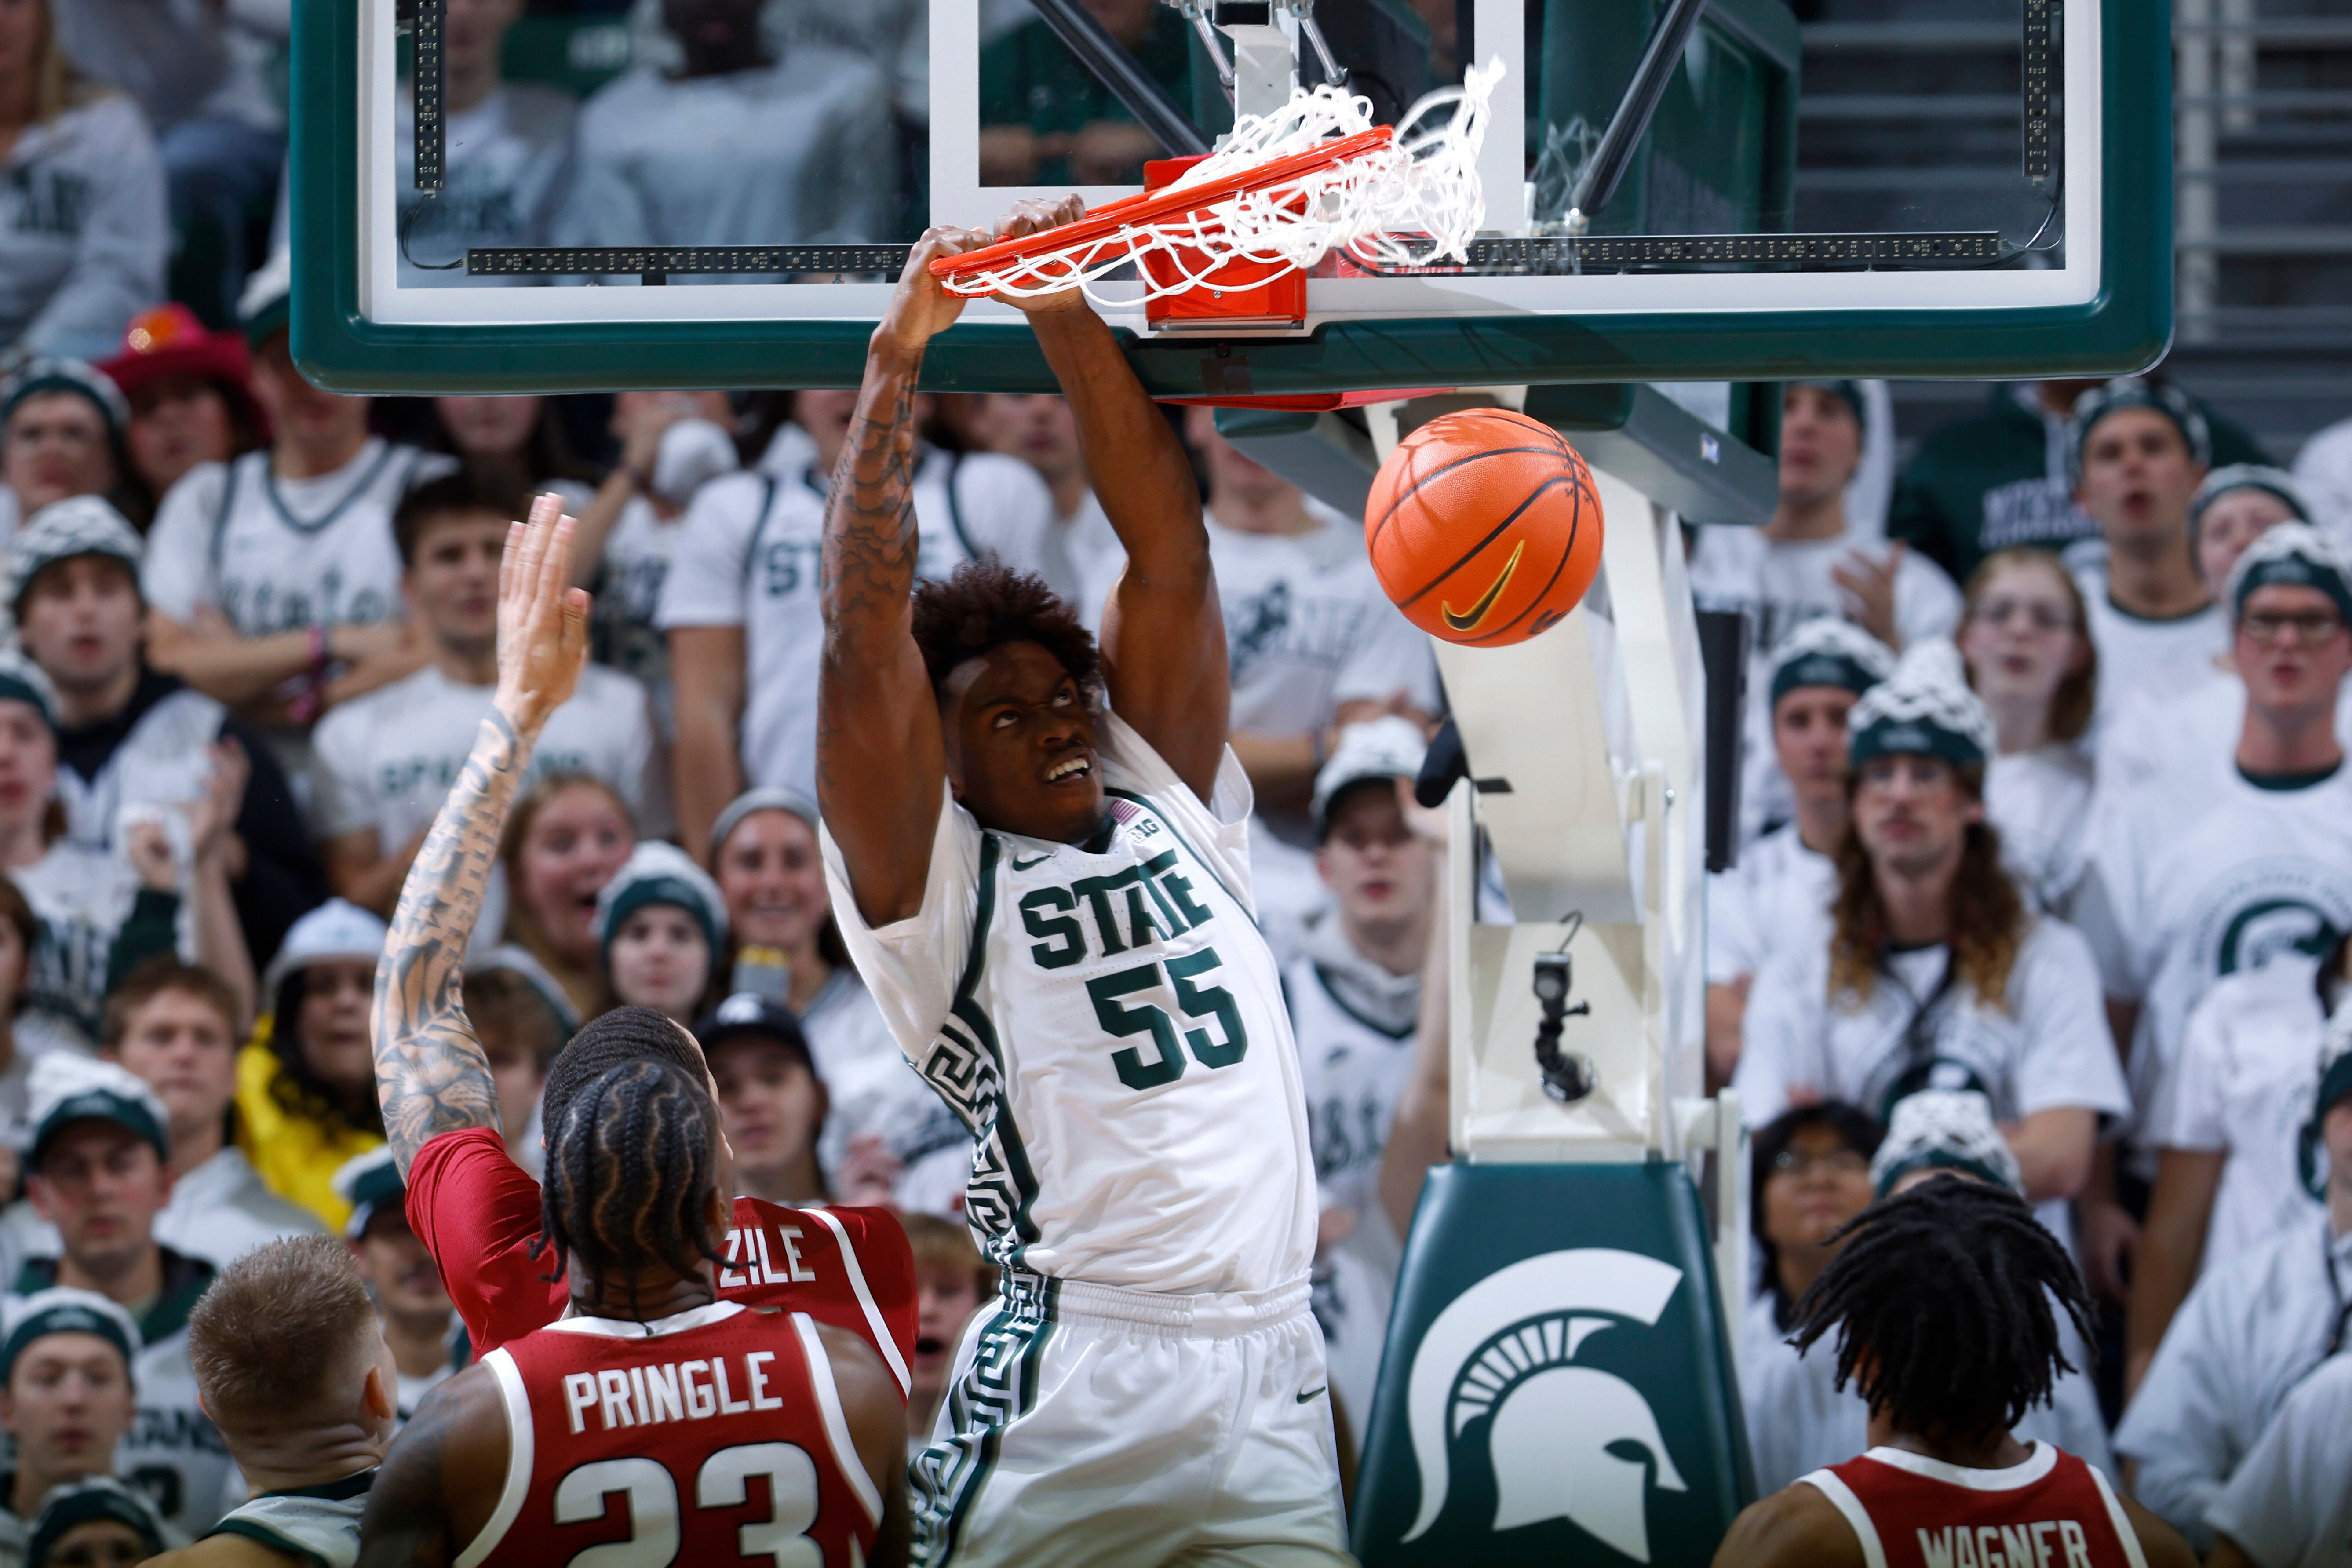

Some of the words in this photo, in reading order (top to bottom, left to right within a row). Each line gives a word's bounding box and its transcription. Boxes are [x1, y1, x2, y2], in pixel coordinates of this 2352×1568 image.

[1018, 848, 1214, 970] STATE
[1085, 946, 1248, 1091] 55
[562, 1350, 784, 1434] PRINGLE
[552, 1440, 826, 1568] 23
[1915, 1519, 2094, 1568] WAGNER
